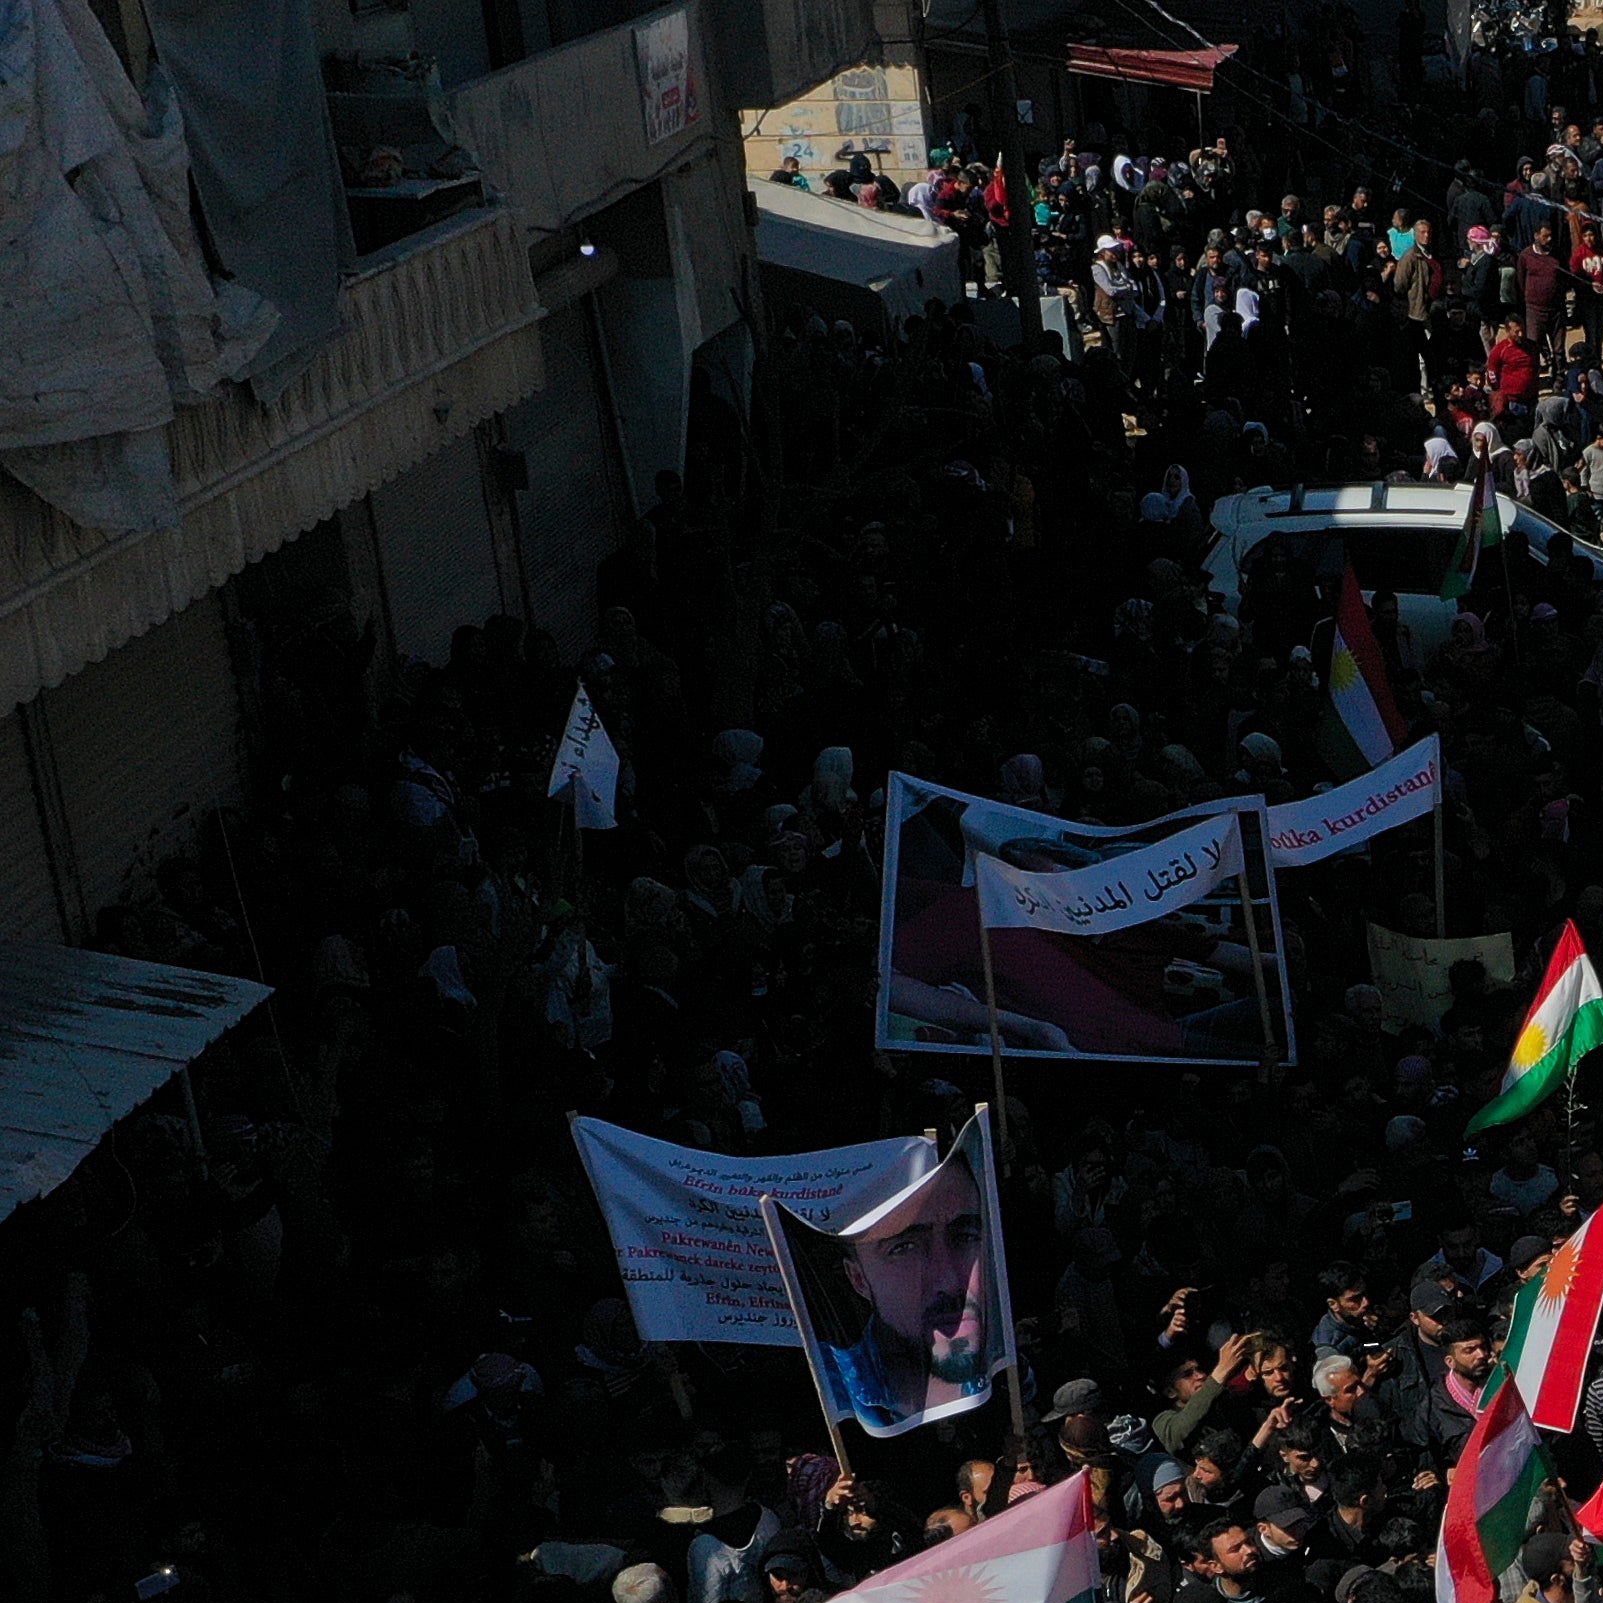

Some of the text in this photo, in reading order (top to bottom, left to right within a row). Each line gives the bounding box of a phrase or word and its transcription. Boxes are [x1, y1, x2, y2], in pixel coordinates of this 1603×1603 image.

[1201, 838, 1222, 871] لا
[1143, 851, 1199, 902] لقتل
[1058, 880, 1135, 926] المدنيين
[660, 1231, 742, 1254] Pakrewanên
